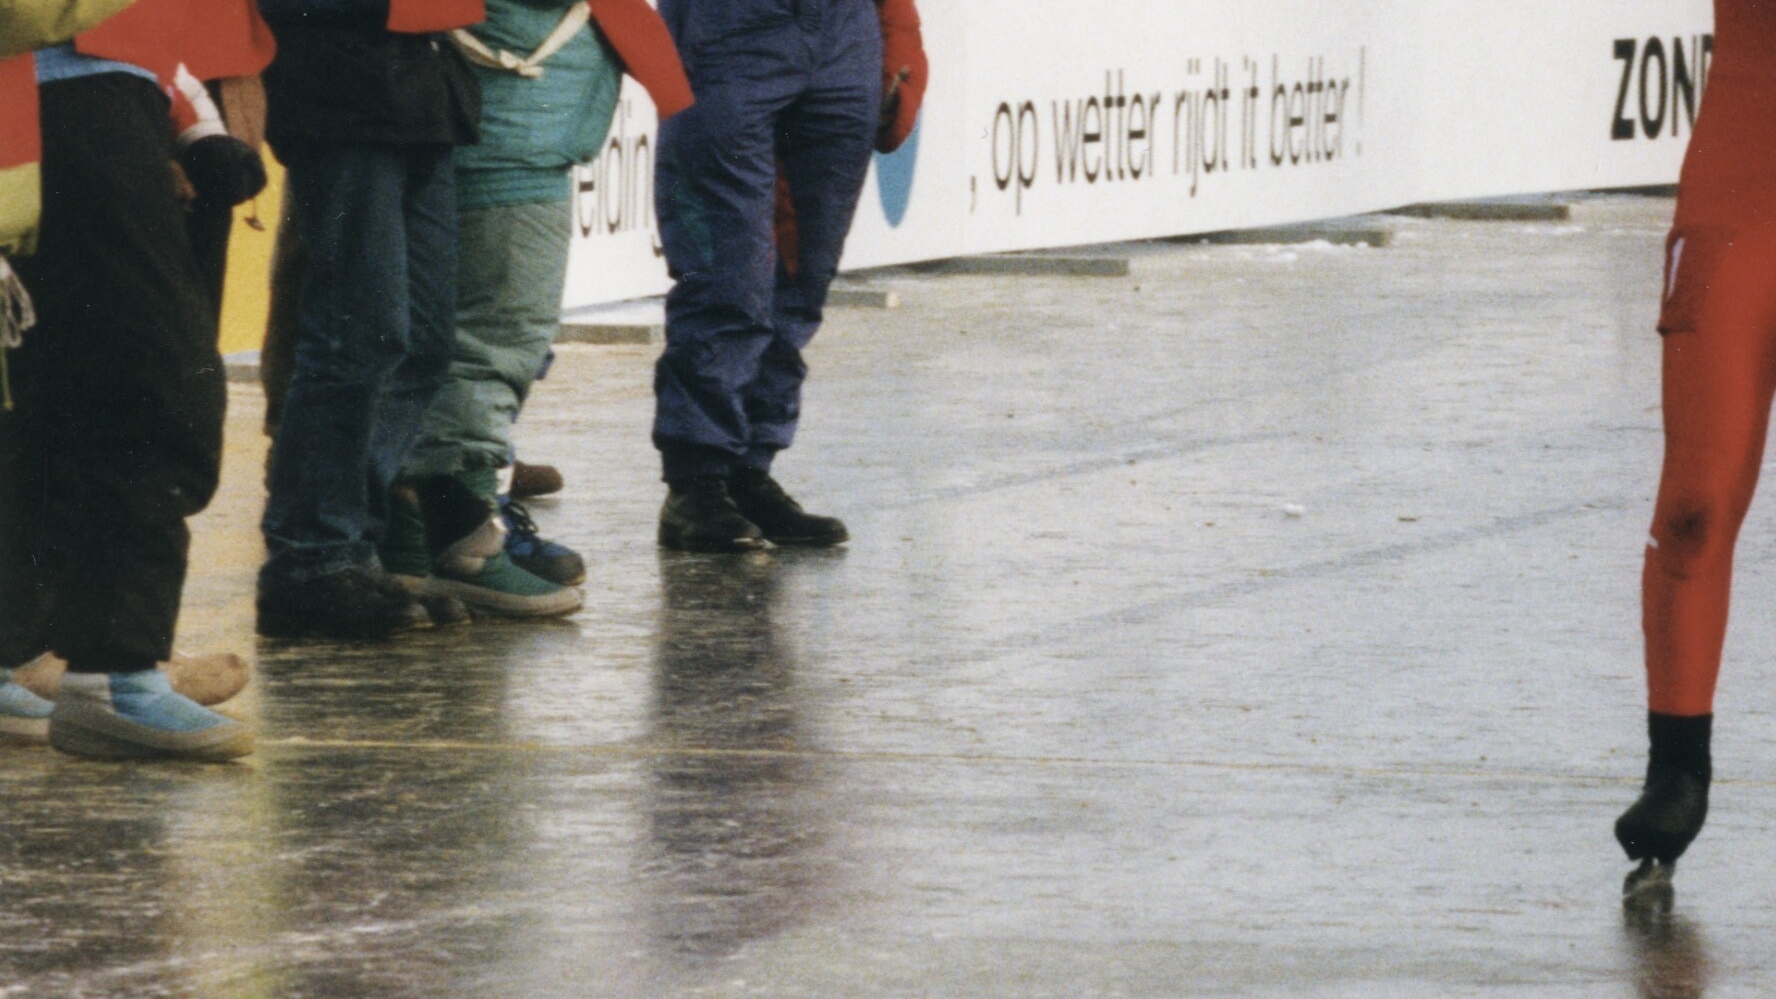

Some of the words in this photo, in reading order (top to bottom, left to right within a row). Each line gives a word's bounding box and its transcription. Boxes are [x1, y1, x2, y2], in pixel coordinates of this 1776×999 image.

[992, 100, 1038, 216] op
[1052, 68, 1161, 184] wetter
[1173, 57, 1230, 197] rijdt
[1241, 54, 1259, 170] it
